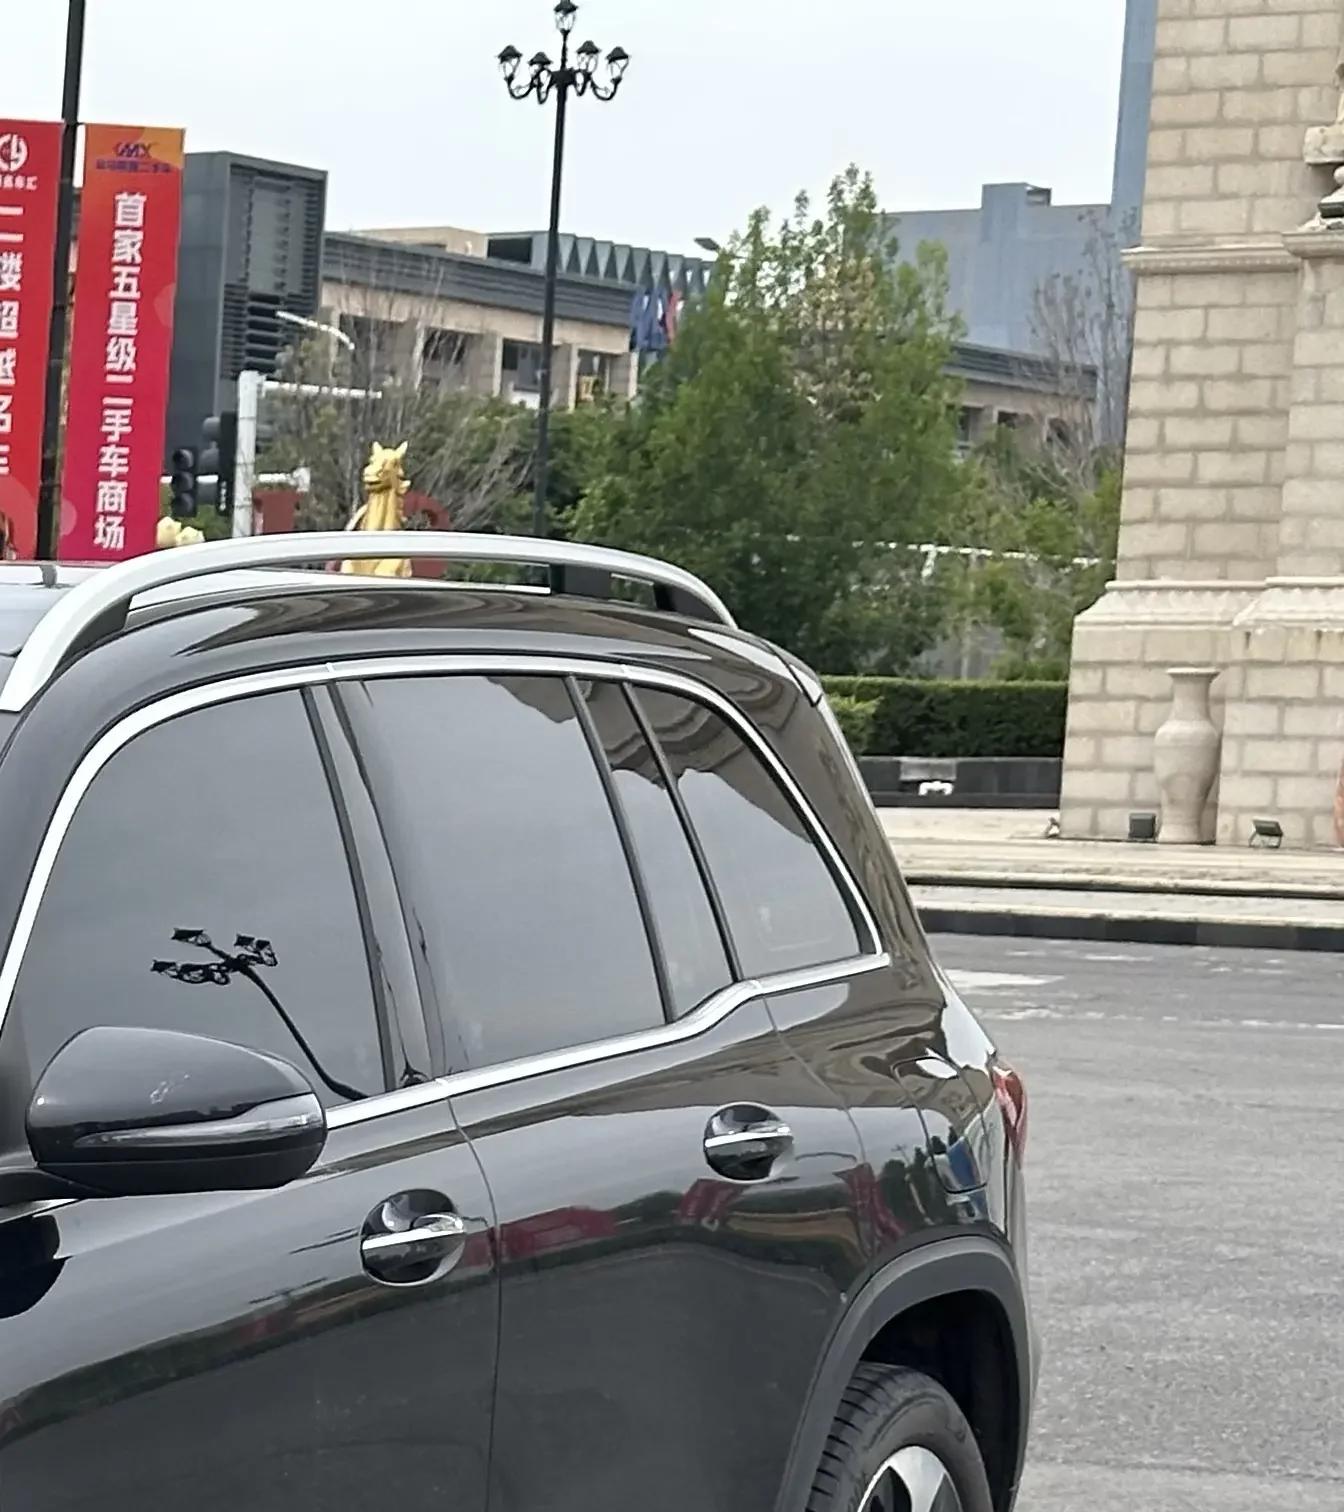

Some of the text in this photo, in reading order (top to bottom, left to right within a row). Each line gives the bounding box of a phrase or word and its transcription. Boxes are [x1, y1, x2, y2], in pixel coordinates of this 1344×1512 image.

[93, 191, 147, 551] 首家五星级二手车商场
